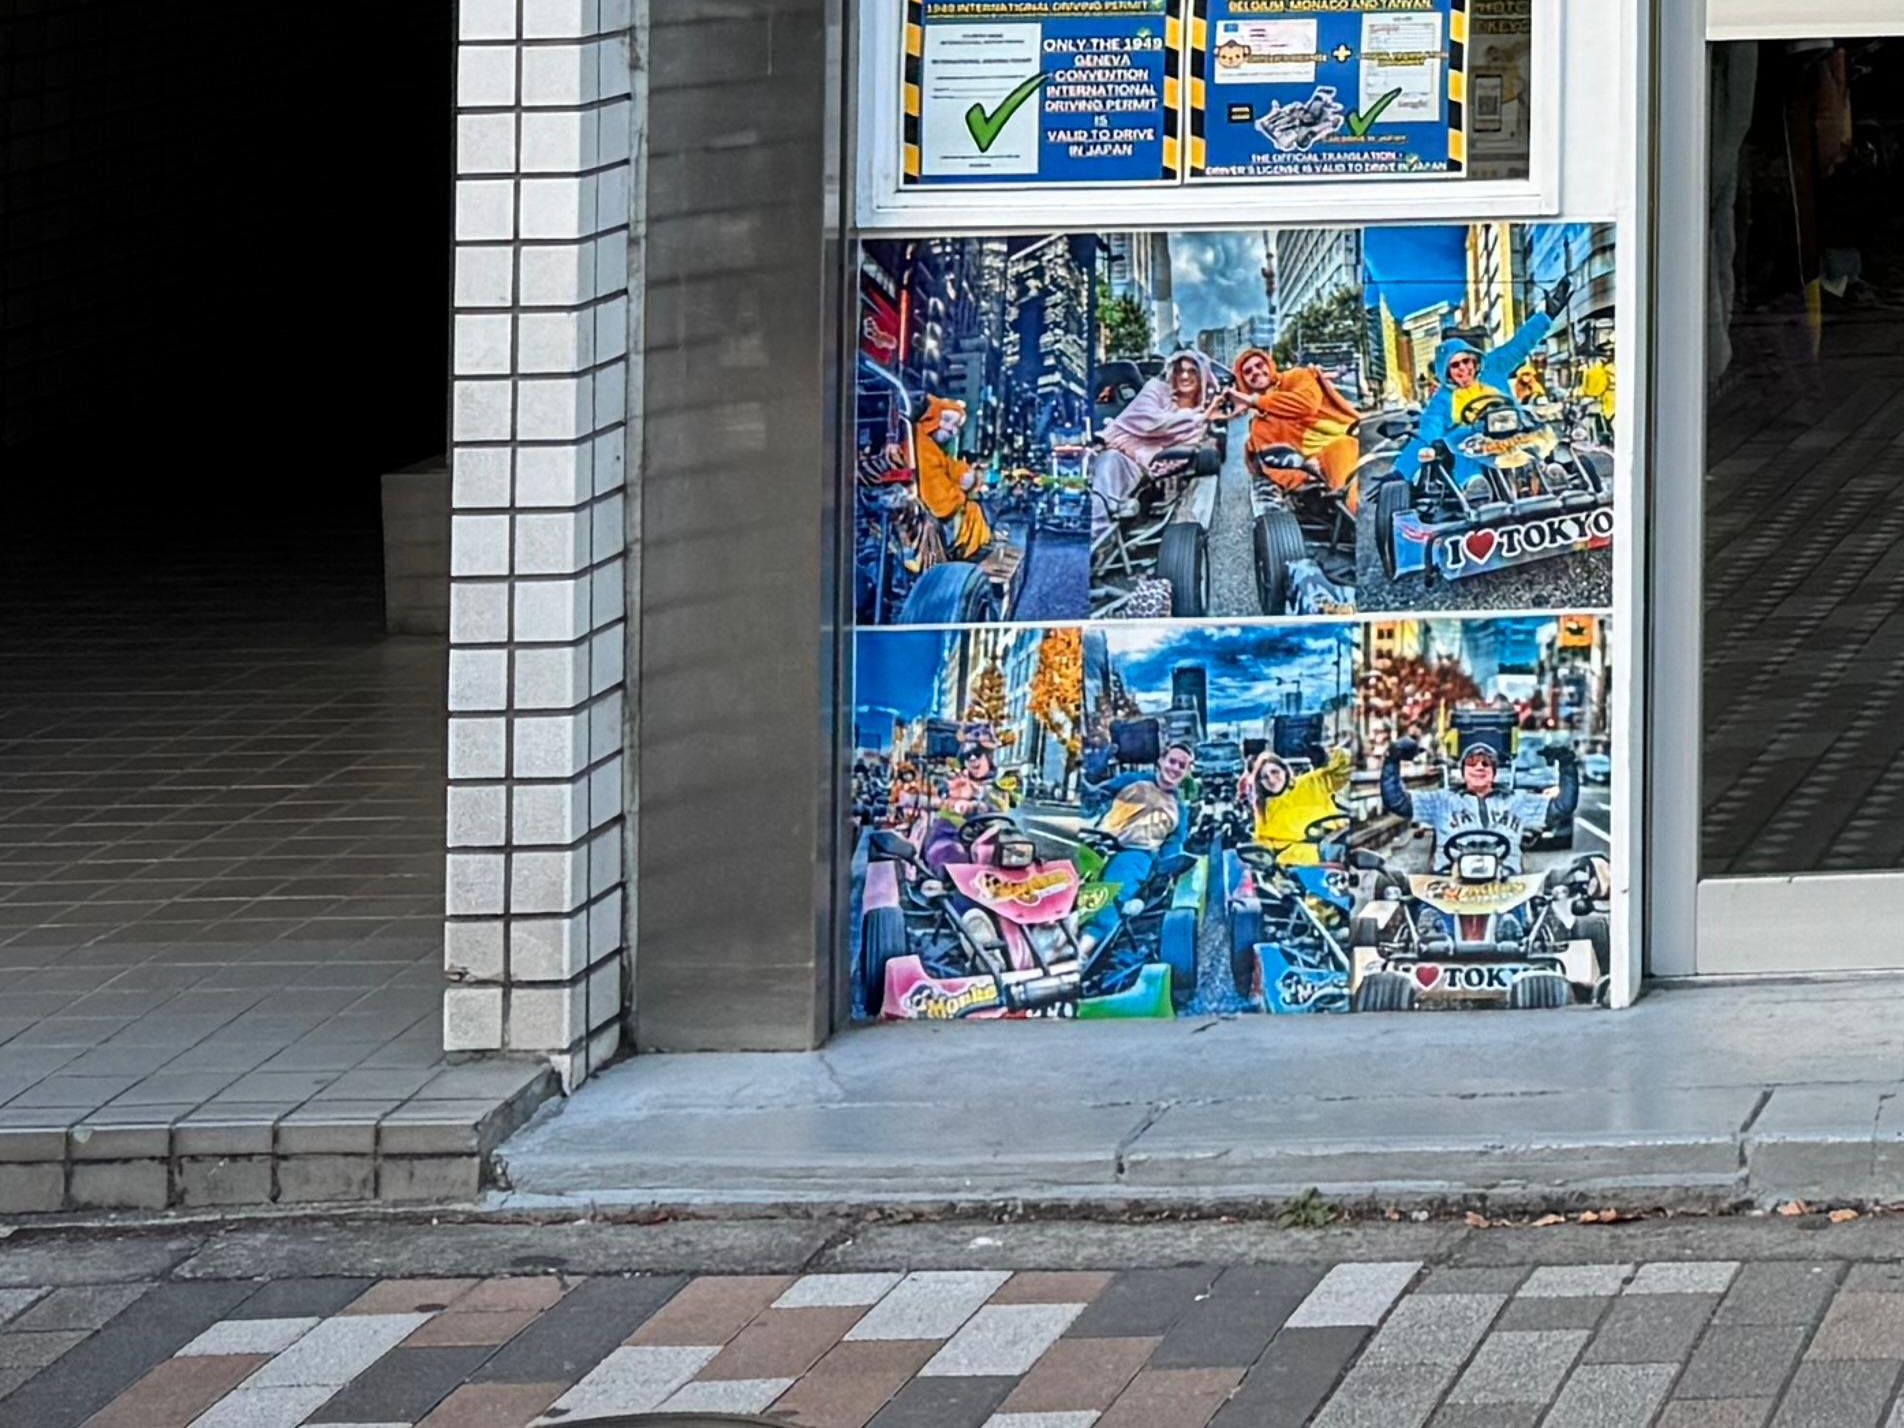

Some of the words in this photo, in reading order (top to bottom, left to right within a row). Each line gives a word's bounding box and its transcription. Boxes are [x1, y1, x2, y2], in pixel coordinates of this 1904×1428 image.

[1043, 39, 1088, 51] ONLY
[1091, 38, 1121, 51] THE
[1124, 37, 1162, 50] 1949
[1074, 54, 1131, 66] GENEVA
[1054, 69, 1149, 81] CONVENTION
[1046, 84, 1156, 97] INTERNATIONAL
[1045, 100, 1103, 112] DRIVING
[1105, 99, 1158, 111] PERMIT
[1095, 115, 1108, 127] IS
[1047, 130, 1088, 142] VALID
[1091, 130, 1111, 141] TO
[1113, 129, 1154, 141] DRIVE
[1069, 146, 1084, 157] IN
[1085, 145, 1133, 156] JAPAN
[1446, 534, 1462, 566] I
[1498, 508, 1613, 556] TOKYO
